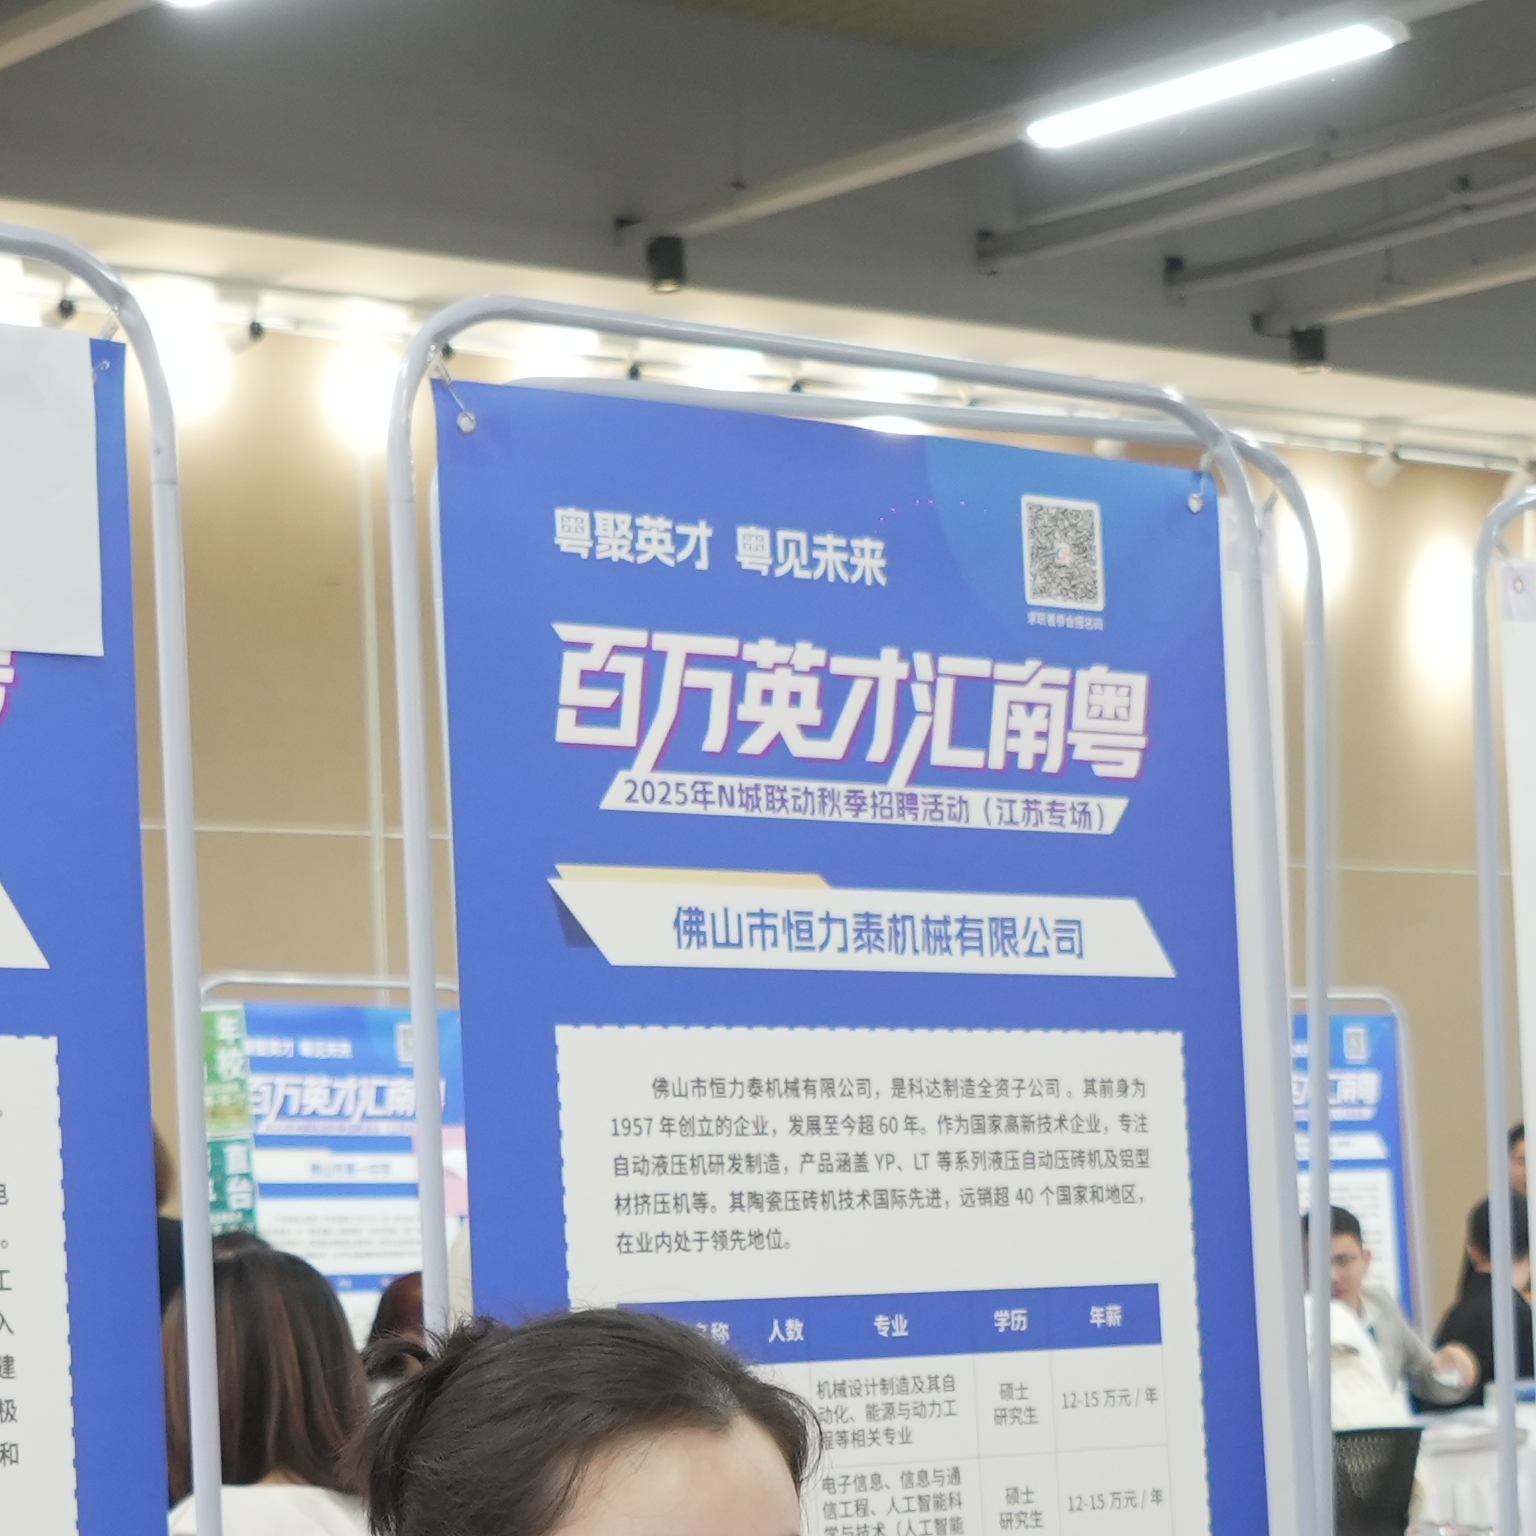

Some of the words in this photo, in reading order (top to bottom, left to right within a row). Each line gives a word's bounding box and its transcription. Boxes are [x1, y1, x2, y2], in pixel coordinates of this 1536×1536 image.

[554, 507, 713, 570] 粤聚英才
[735, 526, 887, 586] 粤见未来
[551, 622, 1149, 785] 百万英才汇南粤
[624, 780, 1107, 832] 2025年N城联动秋季招聘活动（江苏专场）
[673, 906, 1083, 959] 佛山市恒力泰机械有限公司
[612, 1118, 653, 1136] 1957
[879, 1116, 898, 1134] 60
[1016, 1187, 1033, 1204] 40
[769, 1319, 804, 1342] 人数
[874, 1314, 908, 1337] 专业
[994, 1309, 1027, 1332] 学历
[1090, 1305, 1122, 1327] 年薪
[817, 1374, 955, 1399] 机械设计制造及其自
